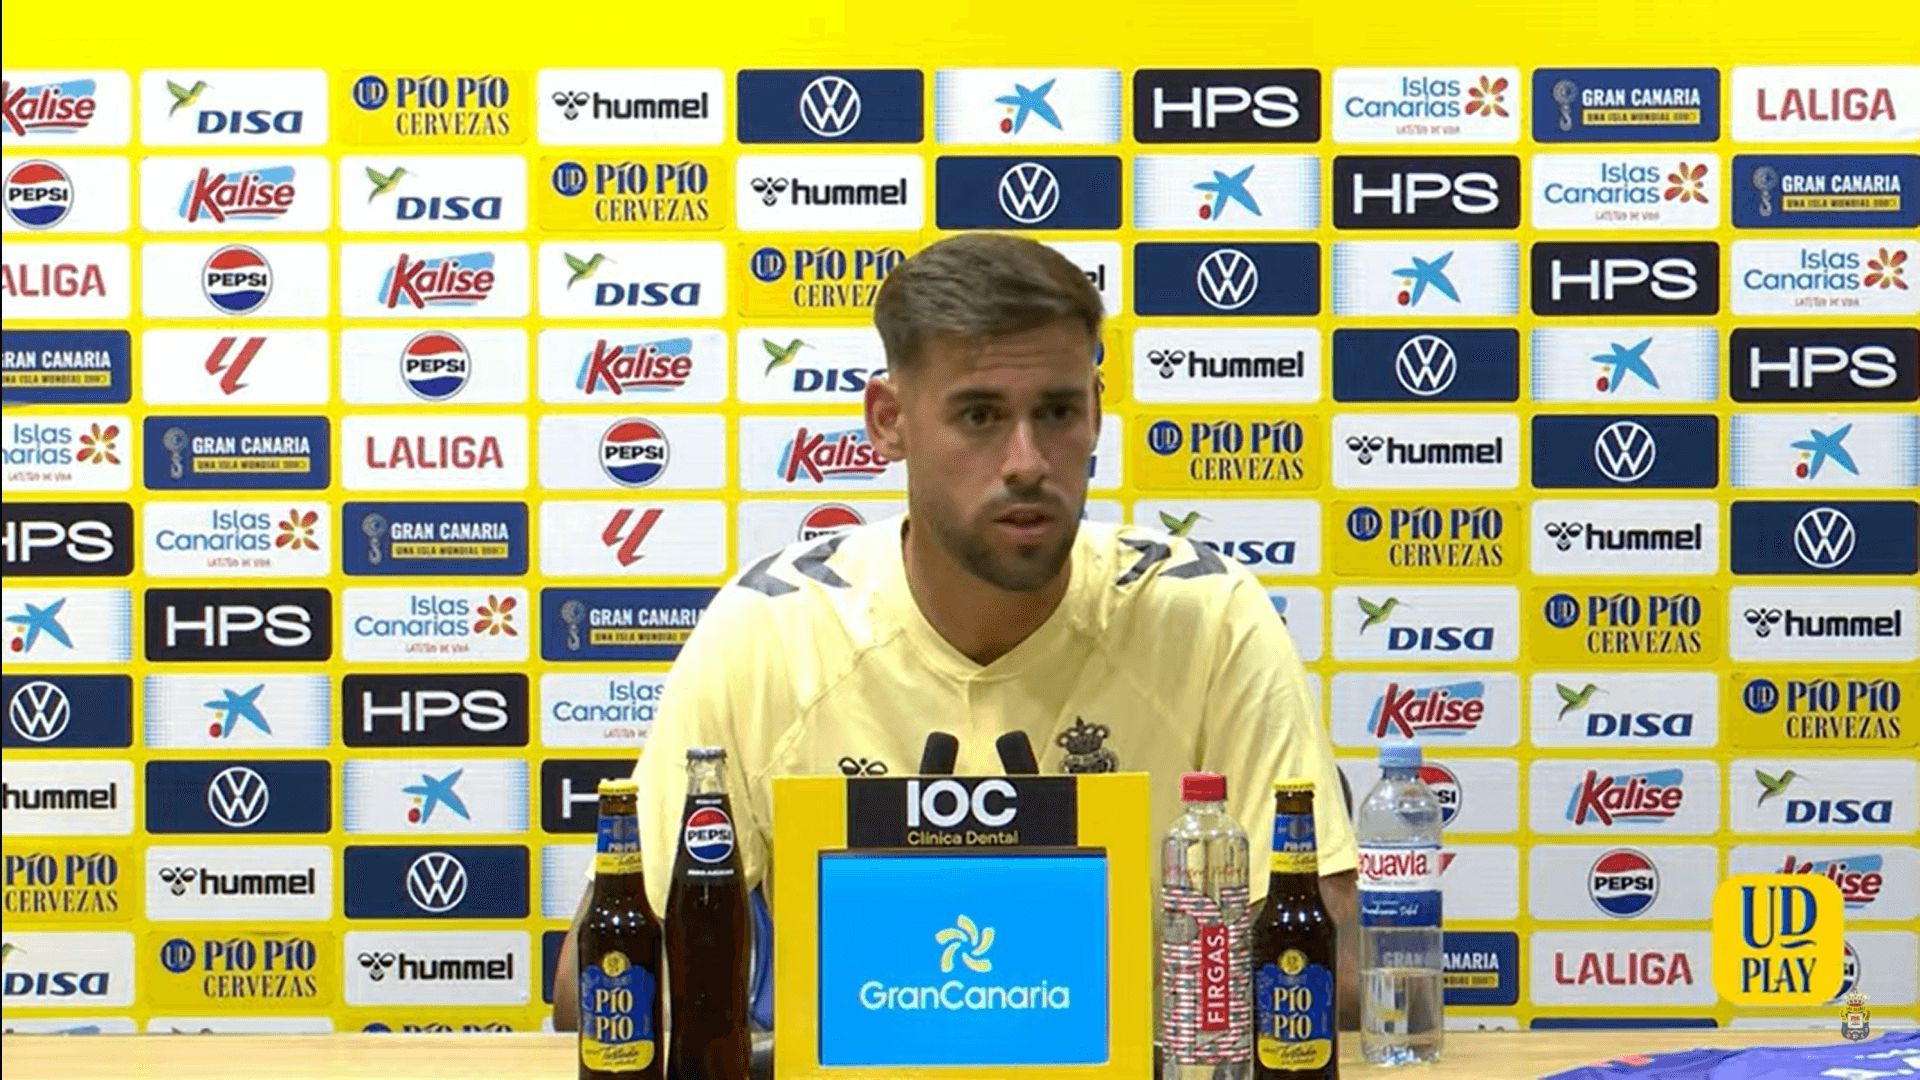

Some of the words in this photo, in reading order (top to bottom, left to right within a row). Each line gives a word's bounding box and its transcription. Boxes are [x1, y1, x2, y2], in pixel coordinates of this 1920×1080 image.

[396, 74, 447, 108] PÍO
[458, 74, 509, 108] PÍO
[1402, 76, 1461, 98] Islas
[1582, 88, 1626, 106] GRAN
[1632, 88, 1700, 106] CANARIA
[593, 93, 707, 119] hummel
[1153, 87, 1299, 128] HPS
[1346, 97, 1461, 118] Canarias
[1757, 88, 1895, 121] LALIGA
[396, 112, 510, 136] CERVEZAS
[595, 160, 646, 194] PÍO
[657, 160, 708, 194] PÍO
[1601, 162, 1660, 184] Islas
[1782, 174, 1826, 192] GRAN
[1832, 174, 1900, 192] CANARIA
[9, 188, 68, 202] PEPSI
[188, 167, 295, 222] Kalise
[792, 179, 906, 205] hummel
[1353, 173, 1499, 214] HPS
[1545, 183, 1660, 204] Canarias
[595, 198, 709, 222] CERVEZAS
[794, 246, 845, 280] PÍO
[1801, 248, 1860, 270] Islas
[2, 263, 106, 297] ALIGA
[208, 273, 267, 287] PEPSI
[388, 253, 495, 308] Kalise
[1551, 259, 1697, 300] HPS
[1745, 269, 1860, 290] Canarias
[794, 284, 877, 308] CERVEZ
[2, 350, 36, 369] RAN
[43, 350, 111, 368] CANARIA
[406, 359, 465, 373] PEPSI
[585, 339, 692, 394] Kalise
[1189, 352, 1303, 378] hummel
[1750, 347, 1896, 388] HPS
[13, 423, 72, 445] Islas
[192, 436, 236, 454] GRAN
[242, 436, 310, 454] CANARIA
[1190, 419, 1241, 453] PÍO
[1252, 419, 1303, 453] PÍO
[365, 436, 503, 469] LALIGA
[605, 446, 664, 460] PEPSI
[1388, 438, 1502, 464] hummel
[1190, 457, 1304, 481] CERVEZAS
[212, 509, 271, 531] Islas
[391, 522, 435, 540] GRAN
[441, 522, 509, 540] CANARIA
[1390, 505, 1441, 539] PÍO
[1452, 505, 1503, 539] PÍO
[156, 530, 271, 551] Canarias
[1586, 524, 1700, 550] hummel
[1390, 543, 1504, 567] CERVEZAS
[411, 595, 470, 617] Islas
[590, 608, 634, 626] GRAN
[1588, 592, 1639, 626] PÍO
[1650, 592, 1701, 626] PÍO
[166, 606, 312, 647] HPS
[355, 616, 470, 637] Canarias
[1786, 611, 1900, 637] hummel
[1588, 630, 1702, 654] CERVEZAS
[1787, 677, 1838, 711] PÍO
[1849, 677, 1900, 711] PÍO
[362, 691, 508, 732] HPS
[552, 701, 656, 722] Canaria
[1377, 683, 1484, 738] Kalise
[1787, 715, 1901, 739] CERVEZAS
[2, 783, 117, 809] hummel
[907, 780, 1017, 827] IOC
[1575, 770, 1682, 825] Kalise
[687, 829, 731, 841] PEPSI
[965, 830, 1019, 845] Dental
[5, 852, 56, 886] PÍO
[67, 852, 118, 886] PÍO
[200, 869, 314, 895] hummel
[1594, 876, 1653, 890] PEPSI
[5, 890, 119, 914] CERVEZAS
[203, 937, 254, 971] PÍO
[265, 937, 316, 971] PÍO
[399, 954, 513, 980] hummel
[1442, 952, 1499, 969] ANARIA
[1554, 952, 1692, 985] LALIGA
[203, 975, 317, 999] CERVEZAS
[859, 979, 1071, 1010] GranCanaria
[1273, 985, 1312, 1012] PÍO
[595, 987, 634, 1014] PÍO
[595, 1014, 634, 1041] PÍO
[1273, 1012, 1312, 1040] PÍO
